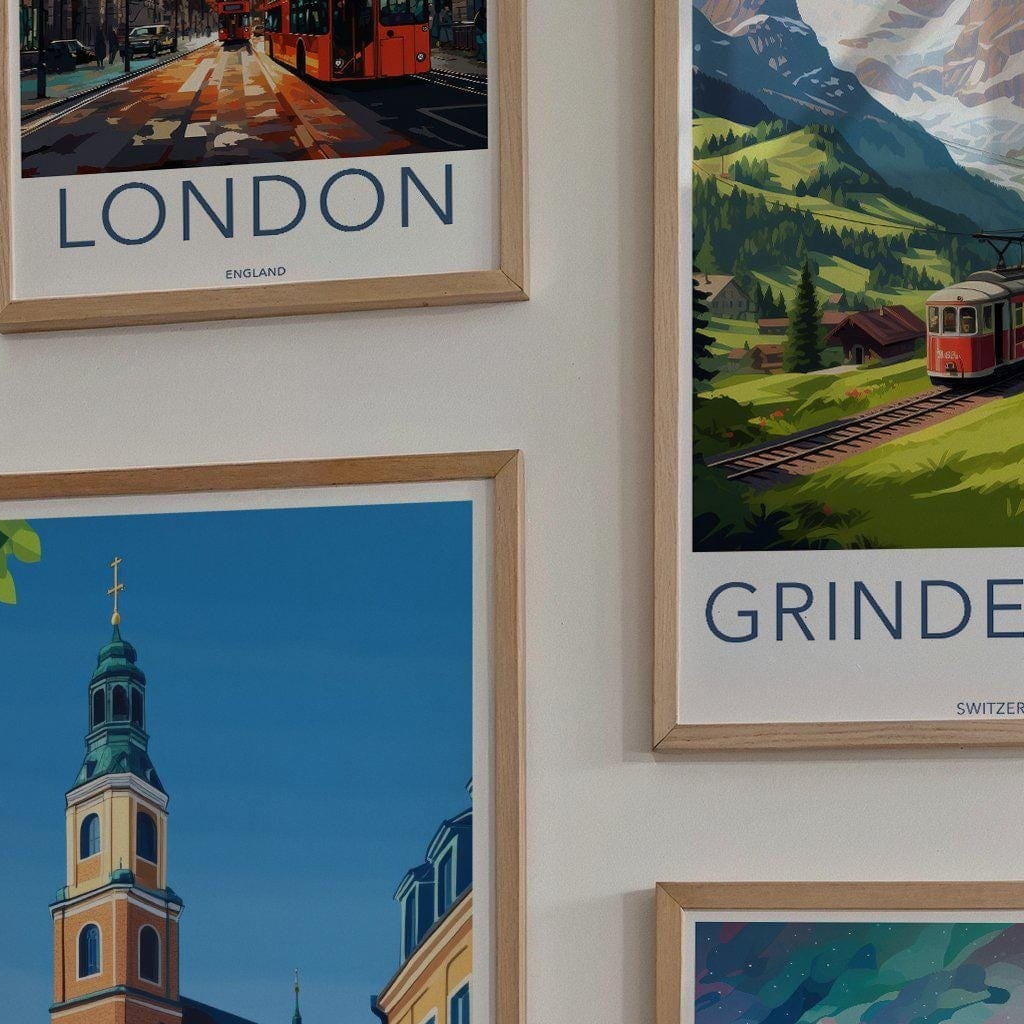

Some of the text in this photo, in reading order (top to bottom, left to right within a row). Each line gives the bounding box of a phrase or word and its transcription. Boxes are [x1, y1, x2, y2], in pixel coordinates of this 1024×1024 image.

[59, 164, 453, 248] LONDON
[225, 267, 286, 279] ENGLAND
[705, 579, 1024, 643] GRINDE
